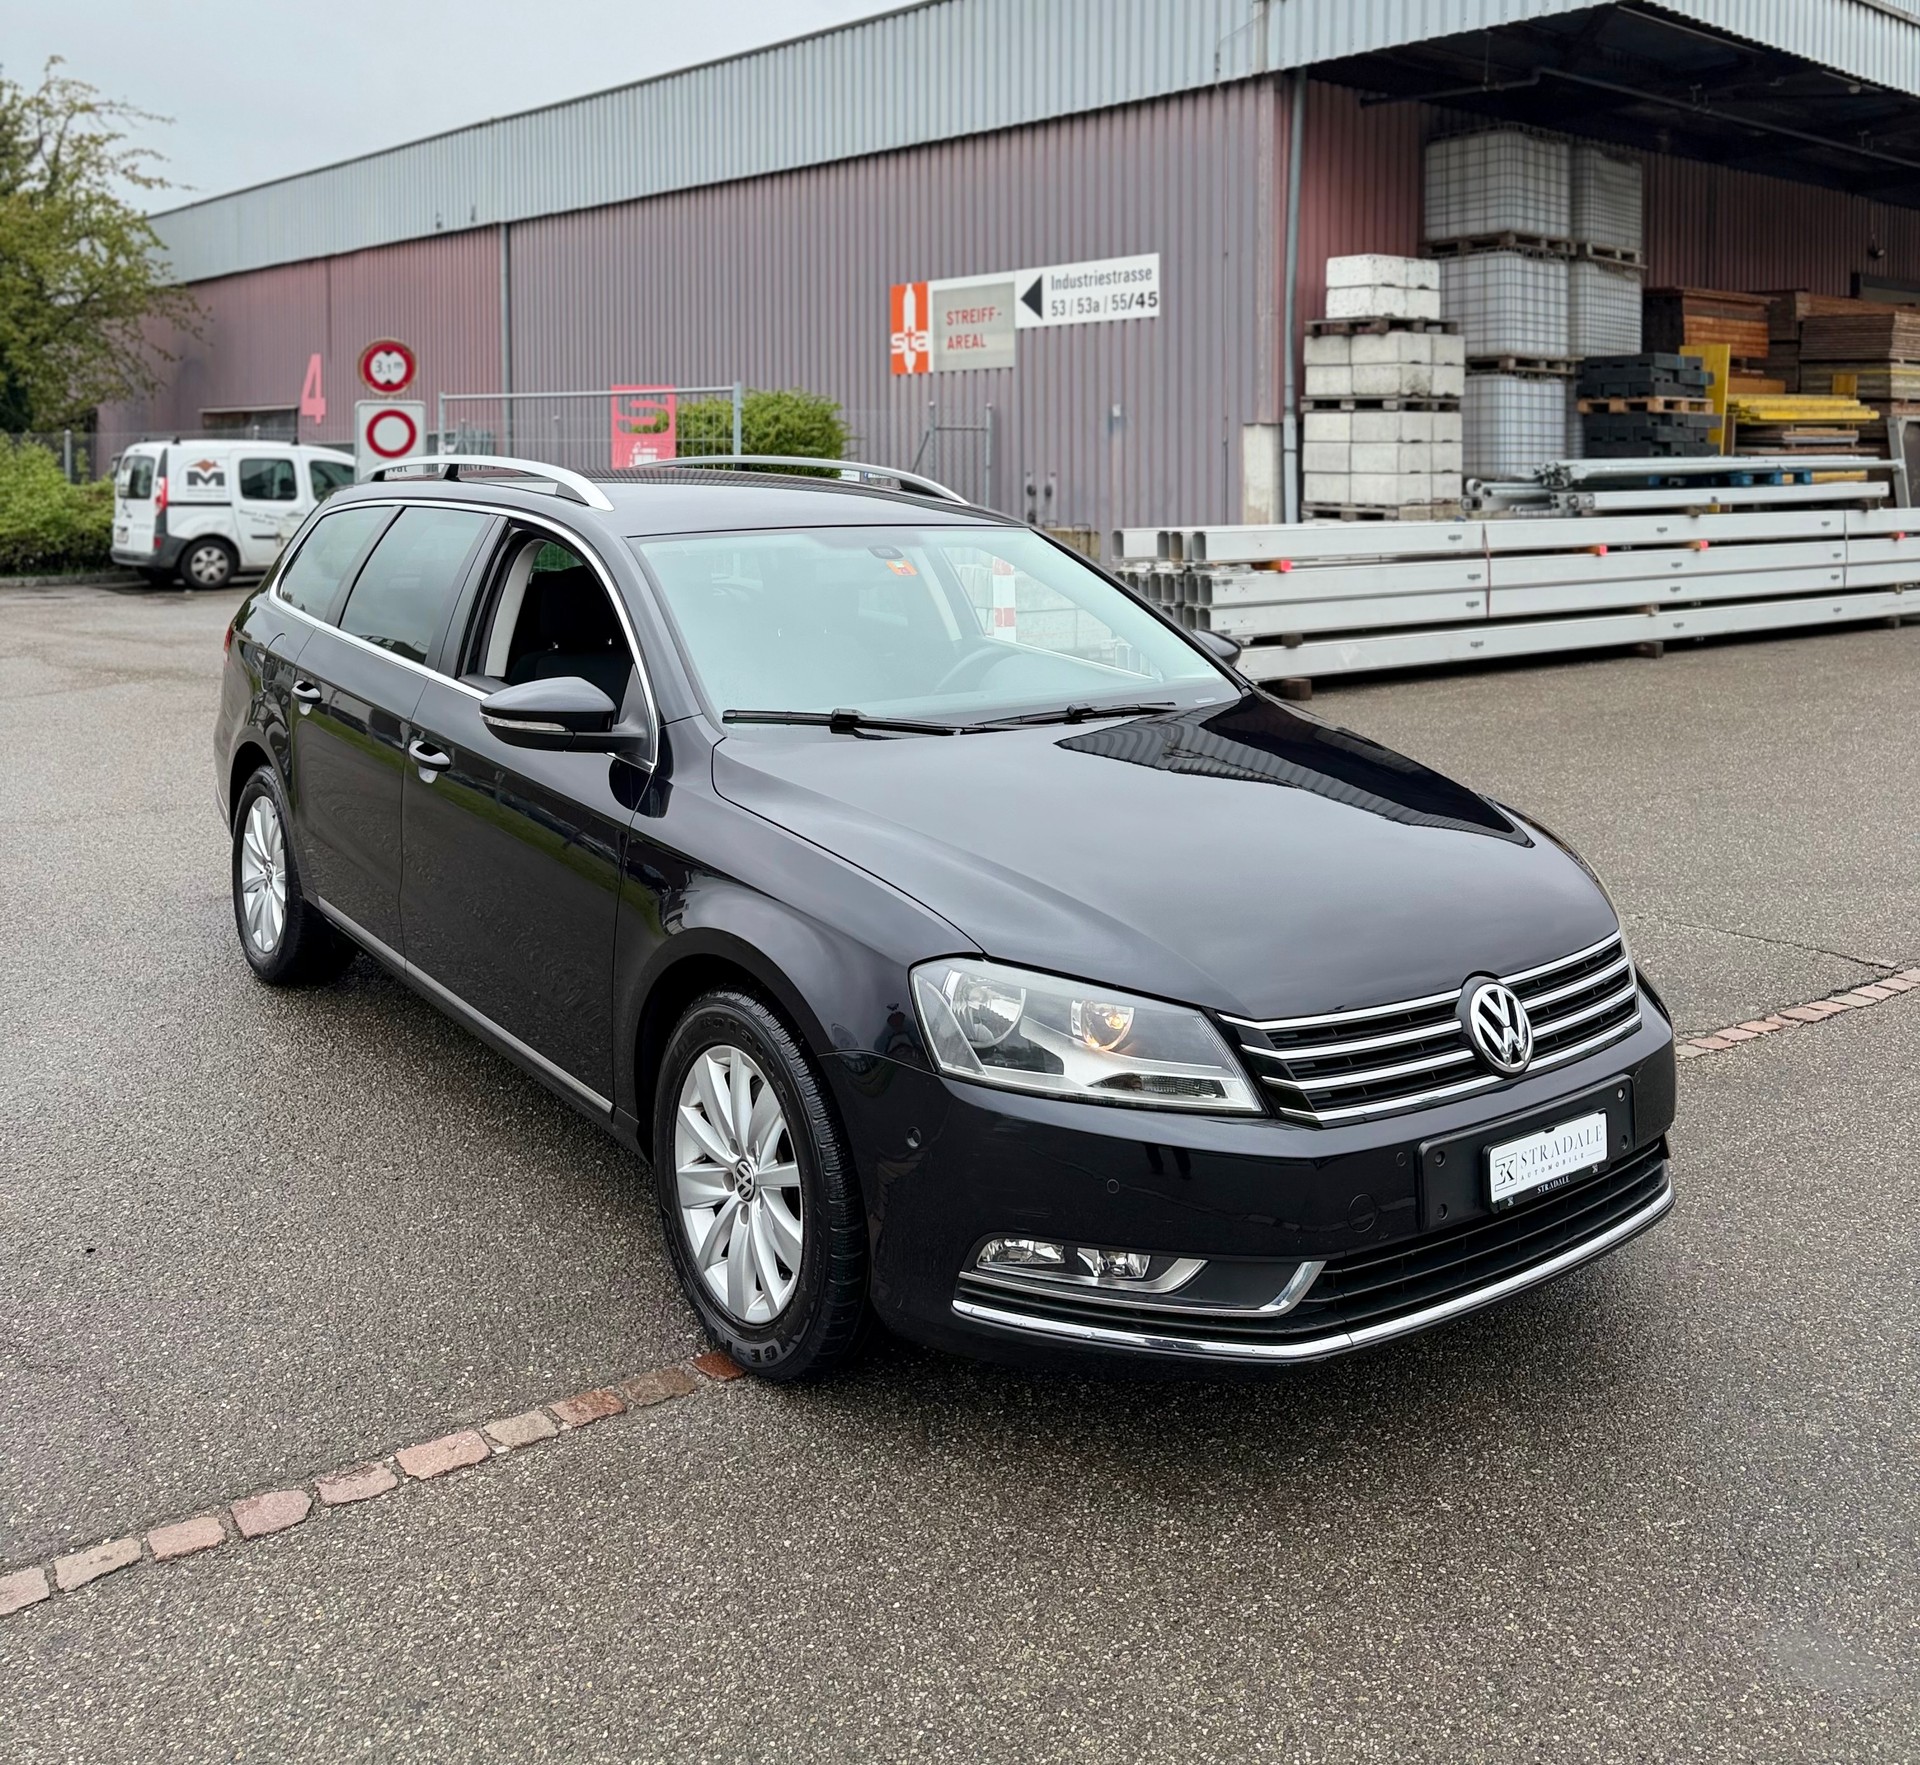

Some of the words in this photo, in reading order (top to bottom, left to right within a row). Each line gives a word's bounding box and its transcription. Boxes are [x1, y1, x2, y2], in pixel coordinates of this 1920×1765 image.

[1051, 267, 1153, 291] Industriestrasse
[946, 306, 1003, 326] STREIFF-
[1051, 300, 1066, 317] 53
[1076, 296, 1100, 314] 53a
[946, 334, 987, 350] AREAL
[301, 352, 326, 424] 4
[1521, 1124, 1603, 1169] STRADALE
[1520, 1152, 1584, 1181] AUTOMOBILE
[1537, 1175, 1571, 1194] STRADALE
